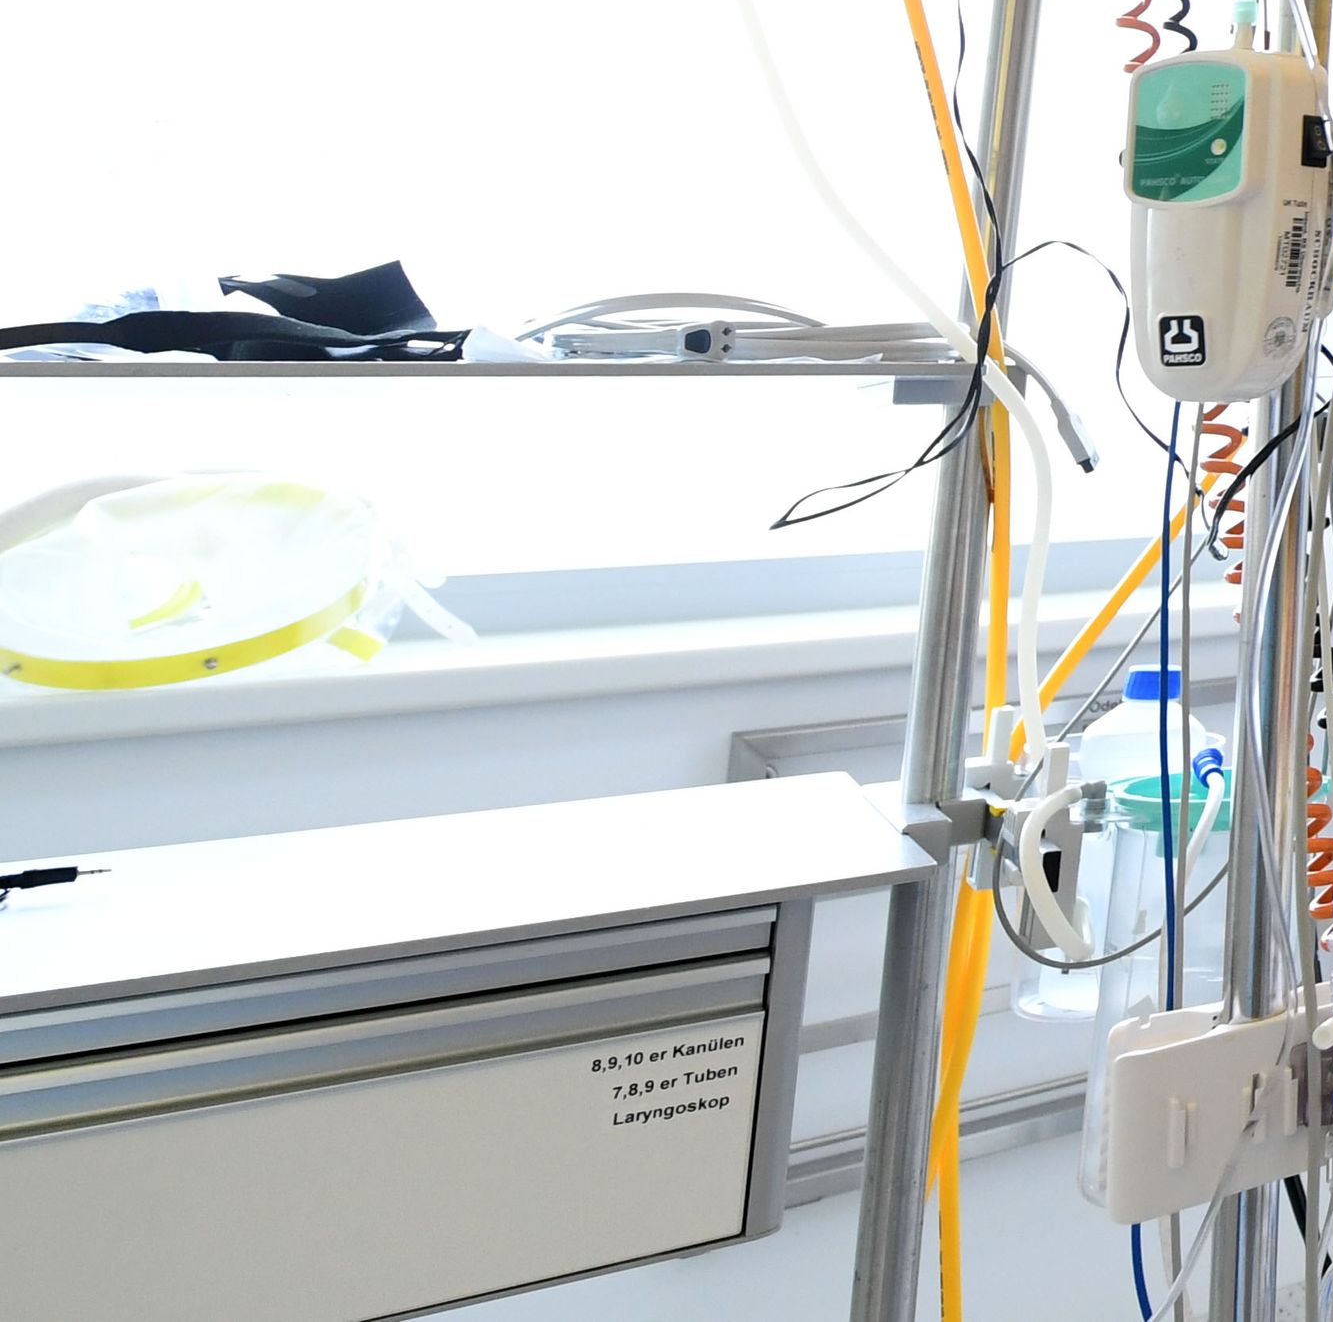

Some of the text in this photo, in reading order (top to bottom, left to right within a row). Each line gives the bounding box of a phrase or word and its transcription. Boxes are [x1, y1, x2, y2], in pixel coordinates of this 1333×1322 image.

[590, 1034, 745, 1074] 8,9,10 er Kanülen
[612, 1063, 739, 1101] 7,8,9 er Tuben
[612, 1093, 731, 1126] Laryngoskop
